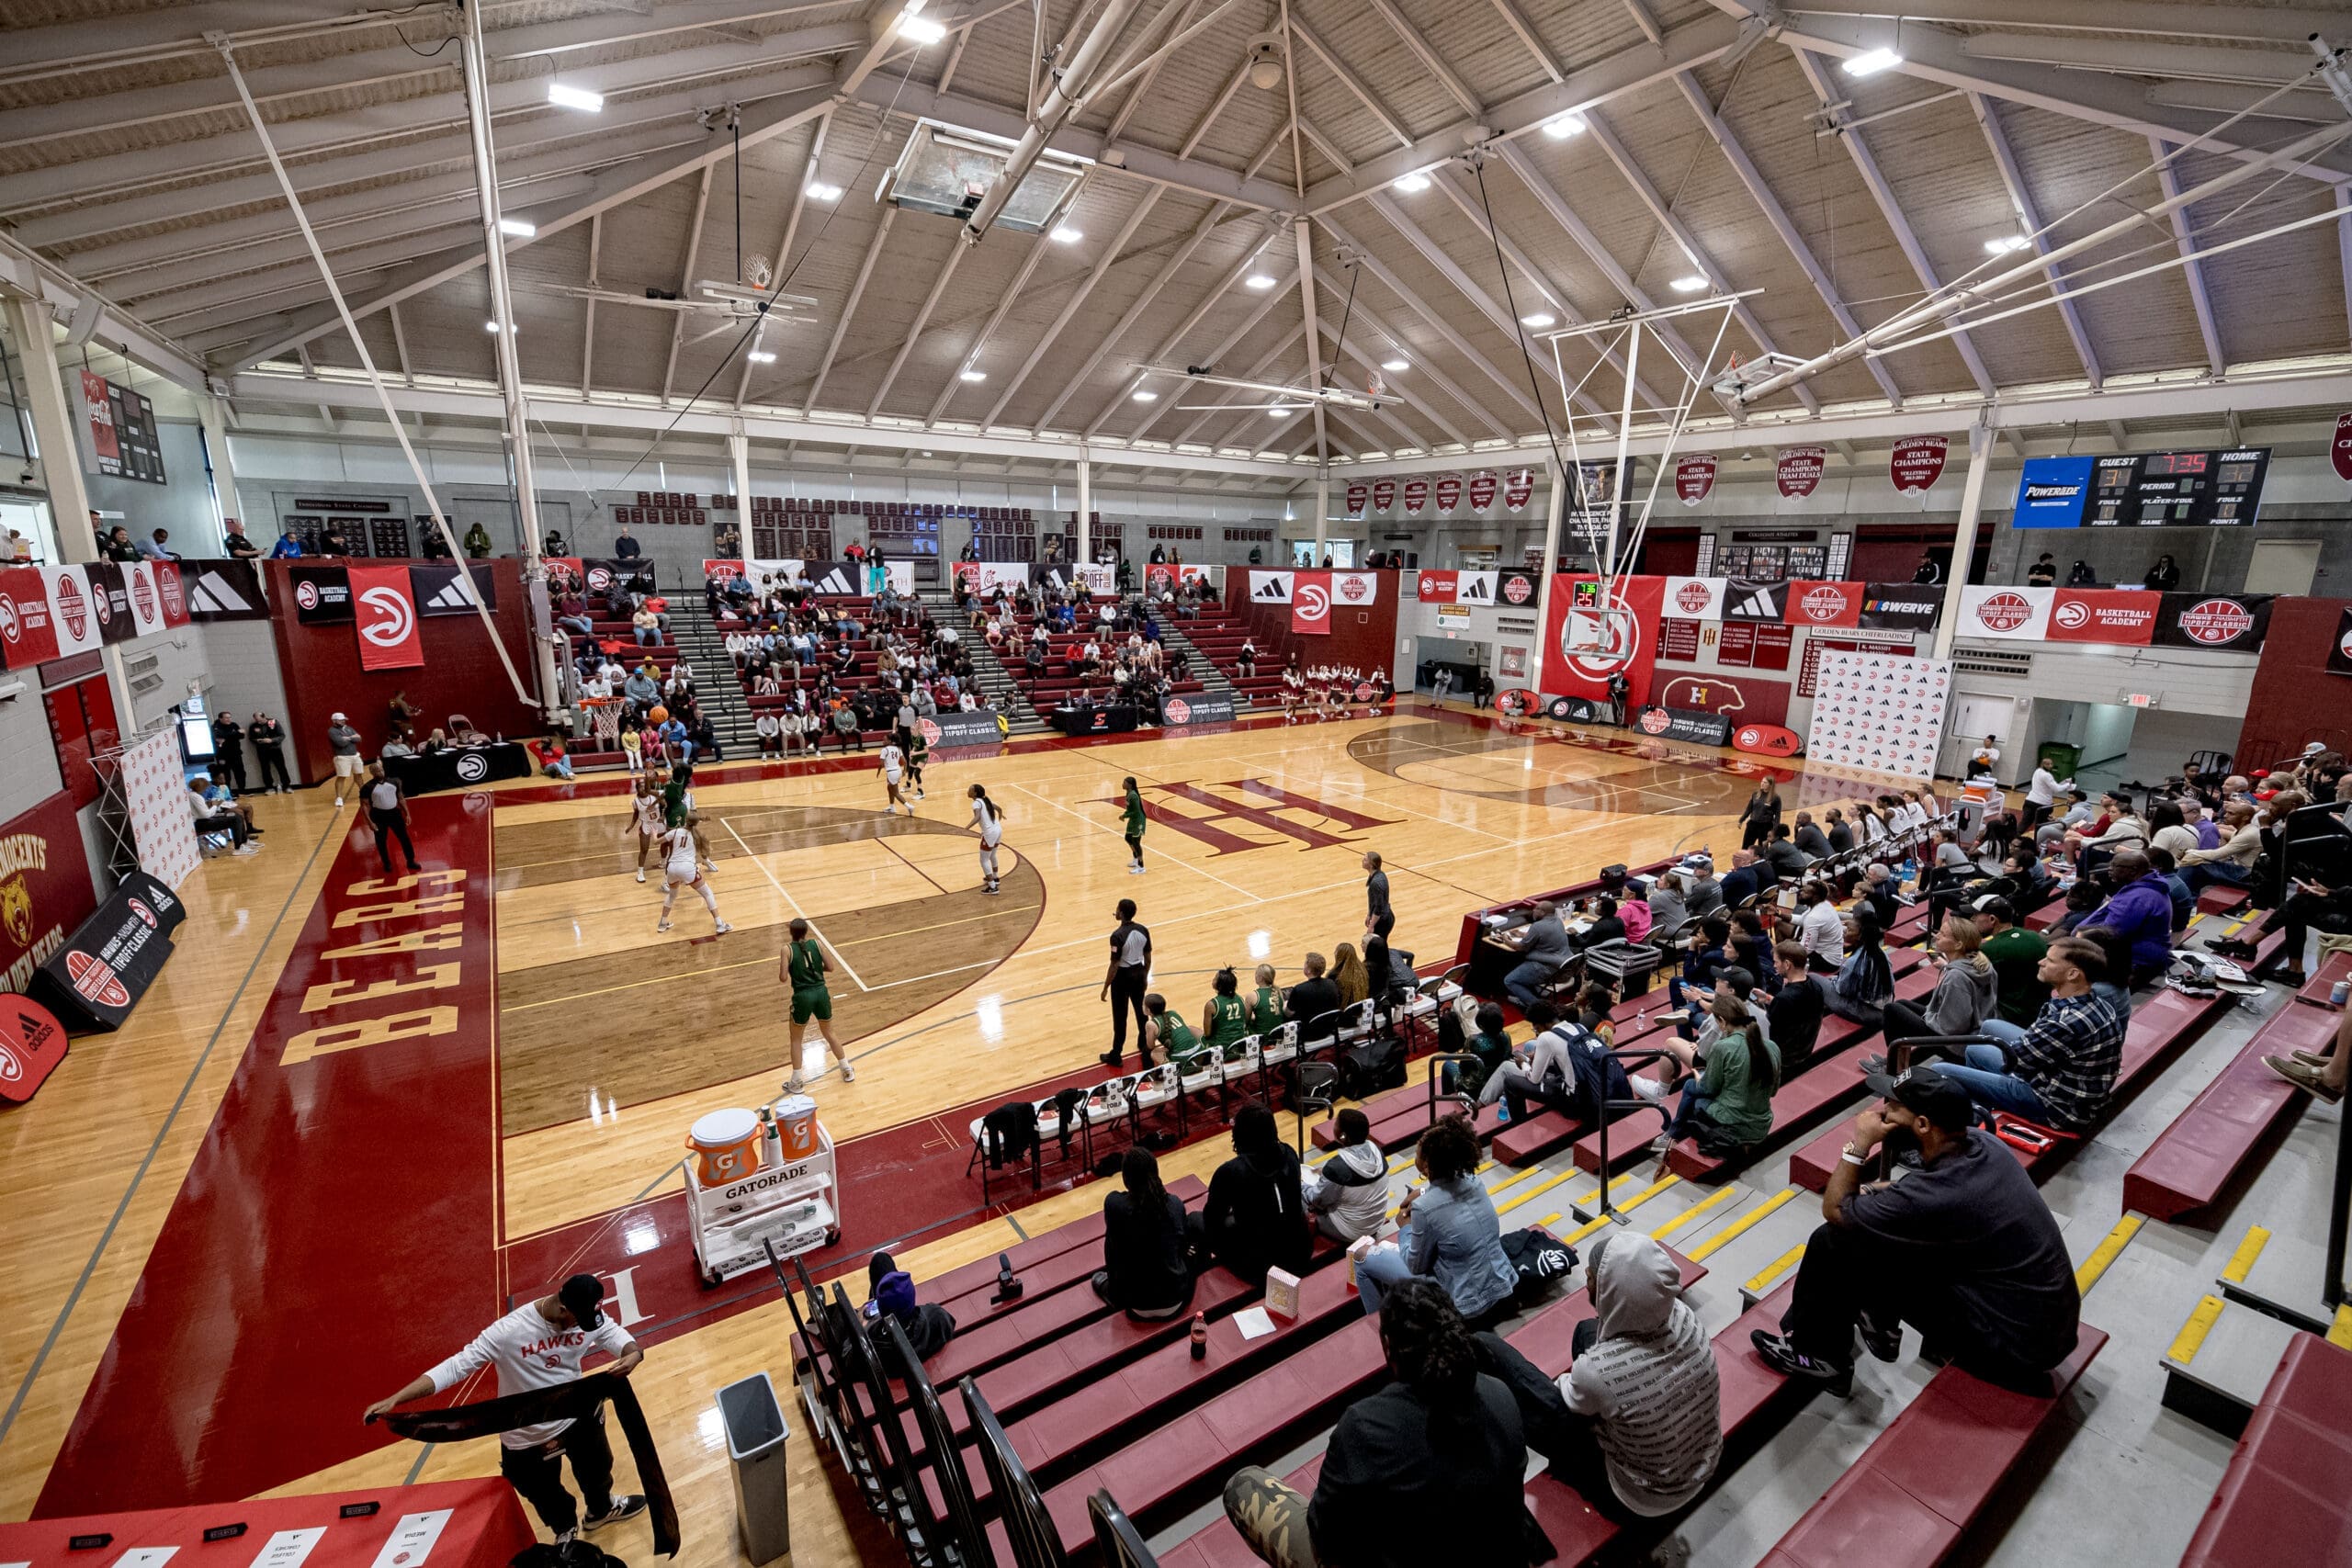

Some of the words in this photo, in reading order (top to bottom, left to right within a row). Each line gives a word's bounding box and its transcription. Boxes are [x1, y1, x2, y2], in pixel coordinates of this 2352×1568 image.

[1894, 441, 1924, 451] GOLDEN
[1779, 451, 1806, 460] GOLDEN
[2221, 452, 2260, 461] HOME
[1679, 458, 1700, 467] GOLDEN
[1894, 457, 1941, 467] CHAMPIONS
[2099, 457, 2138, 467] GUEST
[319, 586, 348, 595] BASKETBALL
[324, 594, 345, 603] ACADEMY
[1577, 592, 1592, 606] 25
[1881, 601, 1935, 615] SWERVE
[2096, 608, 2152, 618] BASKETBALL
[2100, 617, 2143, 626] ACADEMY
[1861, 631, 1909, 639] CHEERLEADING
[1673, 718, 1694, 727] HAWKS
[1698, 722, 1723, 730] NASMITH
[968, 727, 996, 735] CLASSIC
[1672, 724, 1693, 732] TIPOFF
[1694, 727, 1722, 737] CLASSIC
[890, 750, 899, 760] 24
[650, 812, 657, 820] 13
[680, 836, 688, 848] 11
[100, 936, 121, 961] HAWKS
[117, 915, 141, 940] NASMITH
[110, 946, 135, 972] TIPOFF
[128, 924, 153, 953] CLASSIC
[279, 869, 467, 1066] BEARS
[1226, 1002, 1240, 1020] 22
[28, 1023, 54, 1051] adidas
[794, 1121, 807, 1136] G
[717, 1153, 733, 1169] G
[726, 1165, 808, 1200] GATORADE
[783, 1235, 823, 1255] GATORADE
[521, 1332, 585, 1359] HAWKS
[1604, 1360, 1627, 1373] RELIGION
[1798, 1354, 1810, 1367] N
[1615, 1385, 1641, 1397] RELIGION
[405, 1530, 427, 1539] MEDIA
